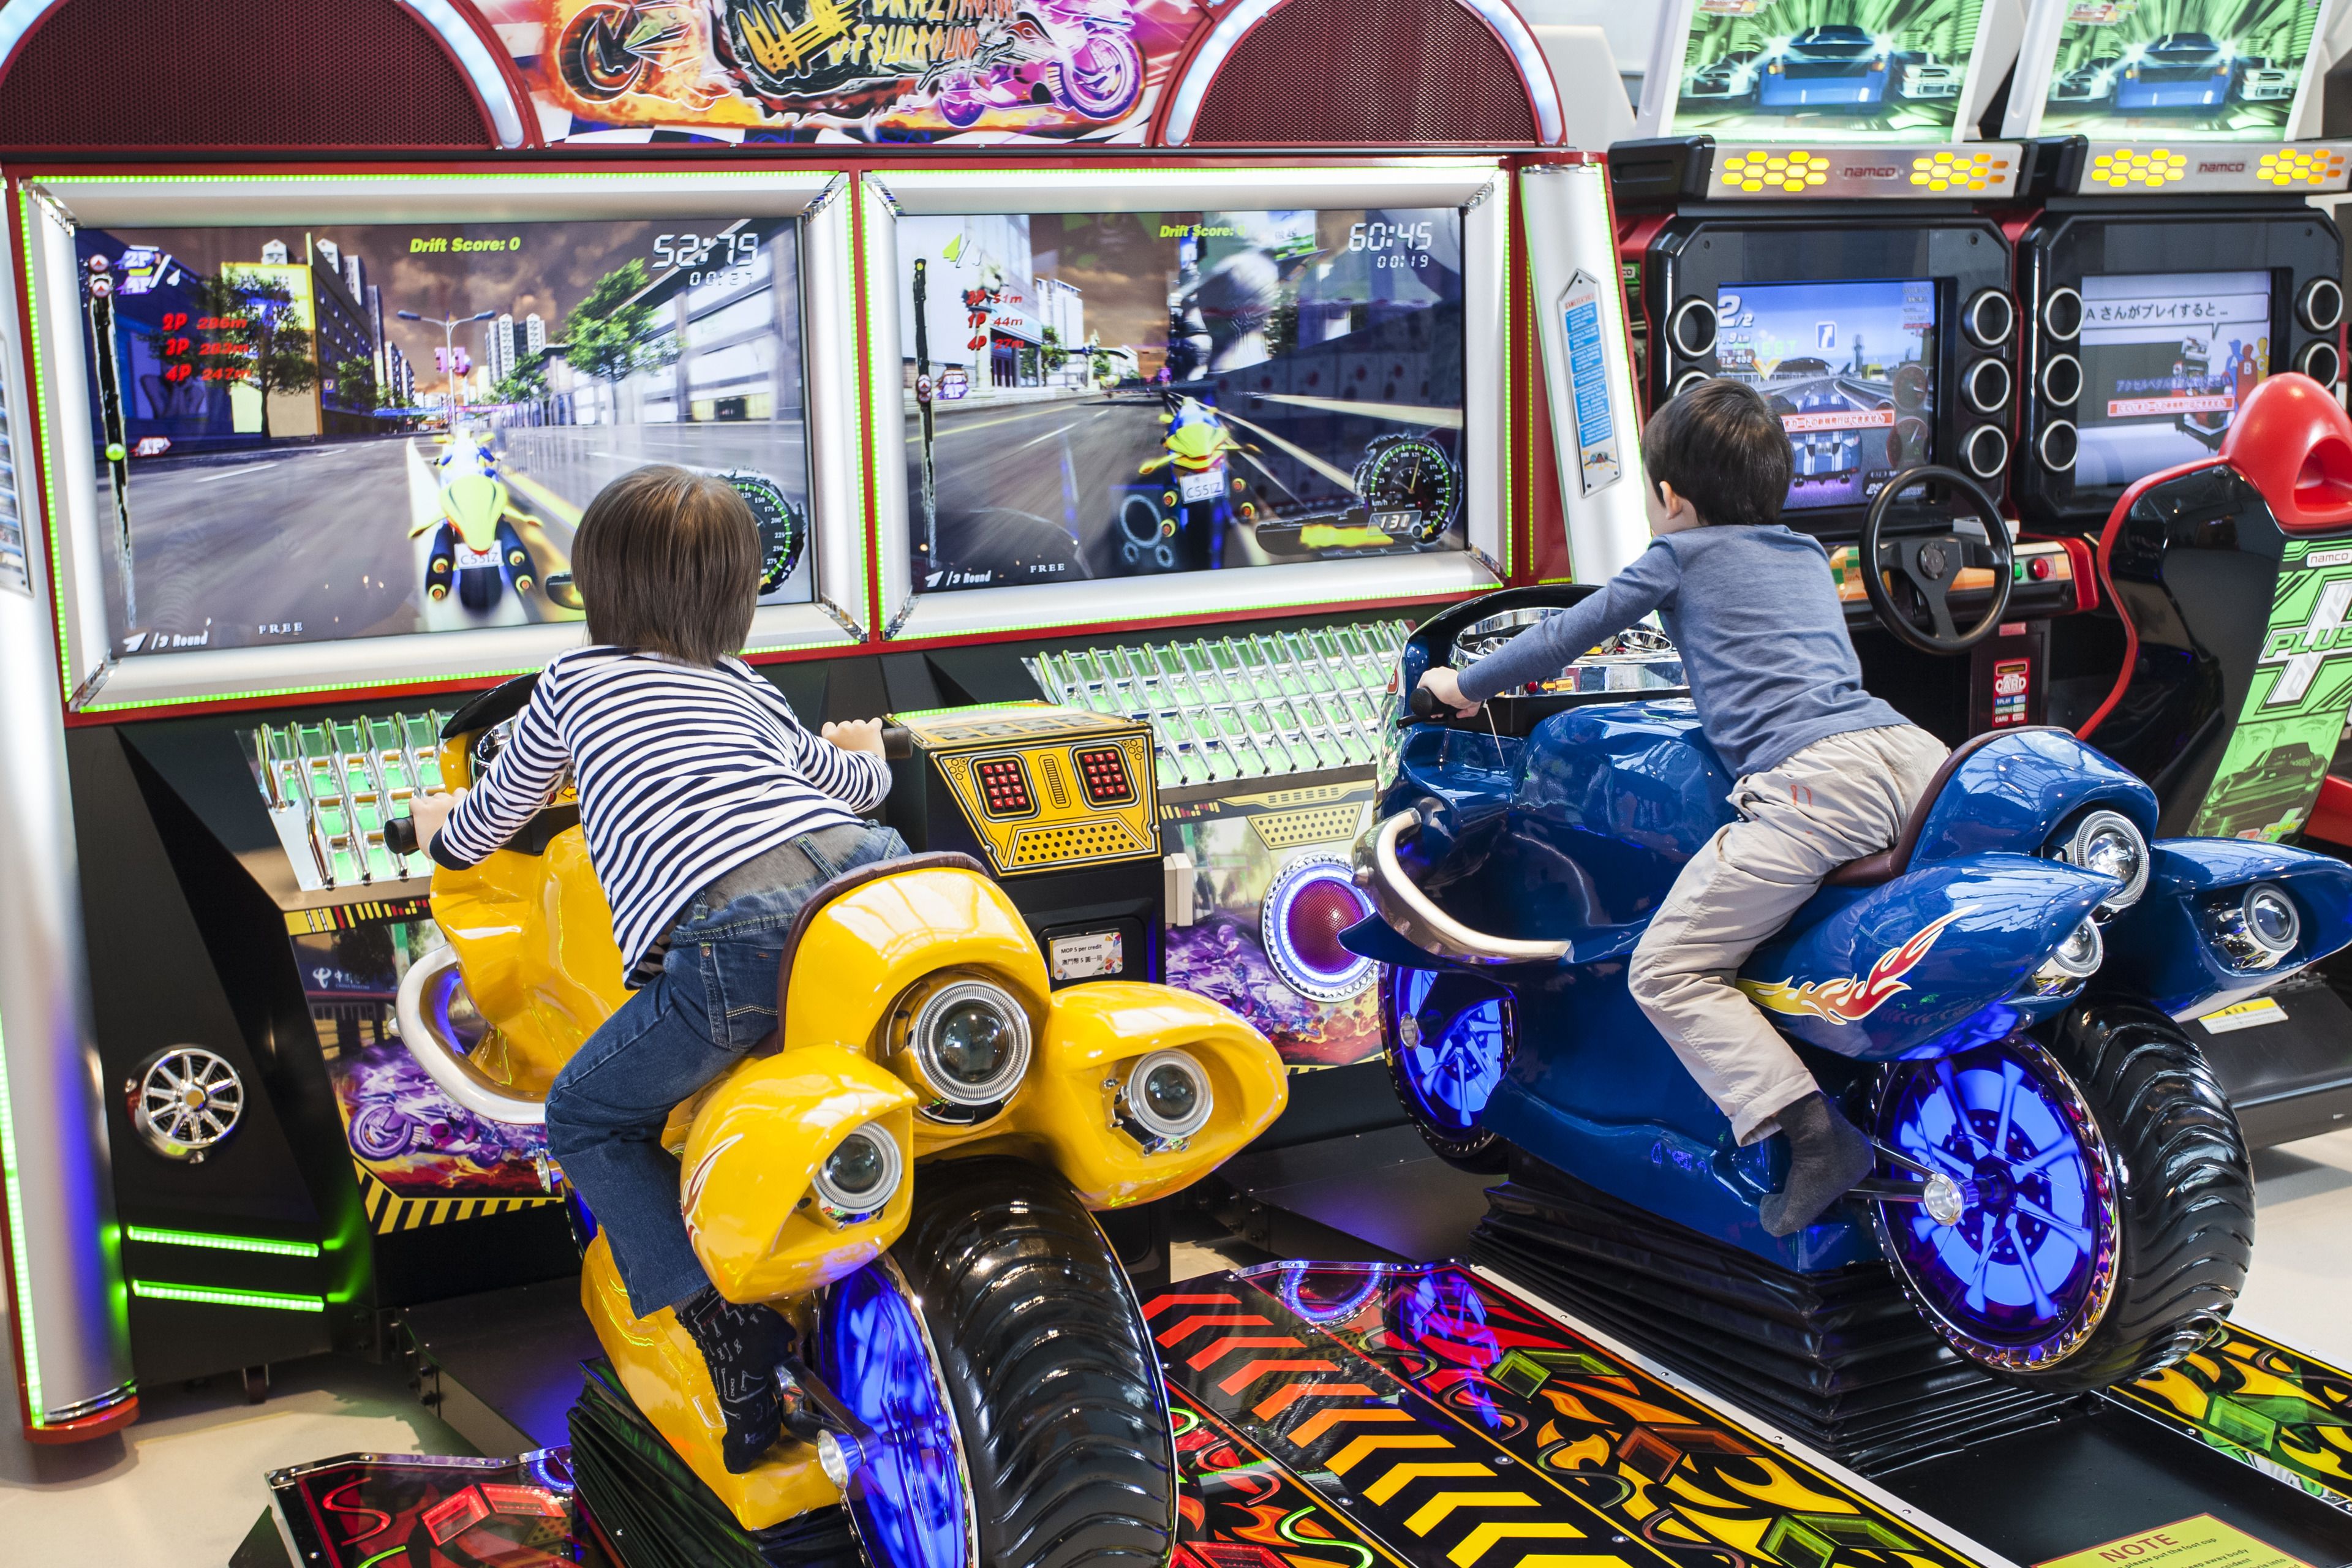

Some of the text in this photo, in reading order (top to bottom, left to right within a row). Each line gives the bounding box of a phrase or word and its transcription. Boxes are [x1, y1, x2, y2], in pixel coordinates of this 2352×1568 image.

[869, 24, 979, 68] SURROUND
[1844, 167, 1896, 177] namco
[2198, 162, 2245, 173] namco
[1159, 225, 1188, 238] Drift
[1193, 224, 1234, 237] Score:
[1348, 222, 1432, 252] 60:45
[409, 236, 521, 253] Drift Score: 0
[651, 232, 760, 270] 52:79
[124, 252, 151, 268] 2P
[1377, 255, 1429, 269] 00:19
[162, 313, 248, 331] 2P 286m
[968, 311, 1023, 328] 1P 44m
[2085, 309, 2095, 320] A
[165, 337, 190, 356] 3P
[968, 335, 1025, 351] 4P 27m
[165, 363, 252, 382] 4P 247m
[2243, 361, 2252, 375] B
[2257, 358, 2265, 371] C
[141, 437, 166, 454] 1P
[1371, 499, 1388, 507] km/h
[2310, 552, 2350, 564] namco
[1030, 564, 1065, 573] FREE
[963, 570, 992, 584] Round
[258, 622, 303, 635] FREE
[173, 630, 209, 648] Round
[1995, 675, 2027, 693] CARD
[2098, 1533, 2179, 1563] NOTE
[2152, 1552, 2169, 1561] put
[2181, 1542, 2200, 1551] foot
[2201, 1537, 2217, 1547] cup
[2205, 1555, 2228, 1565] away
[2226, 1548, 2249, 1558] body
